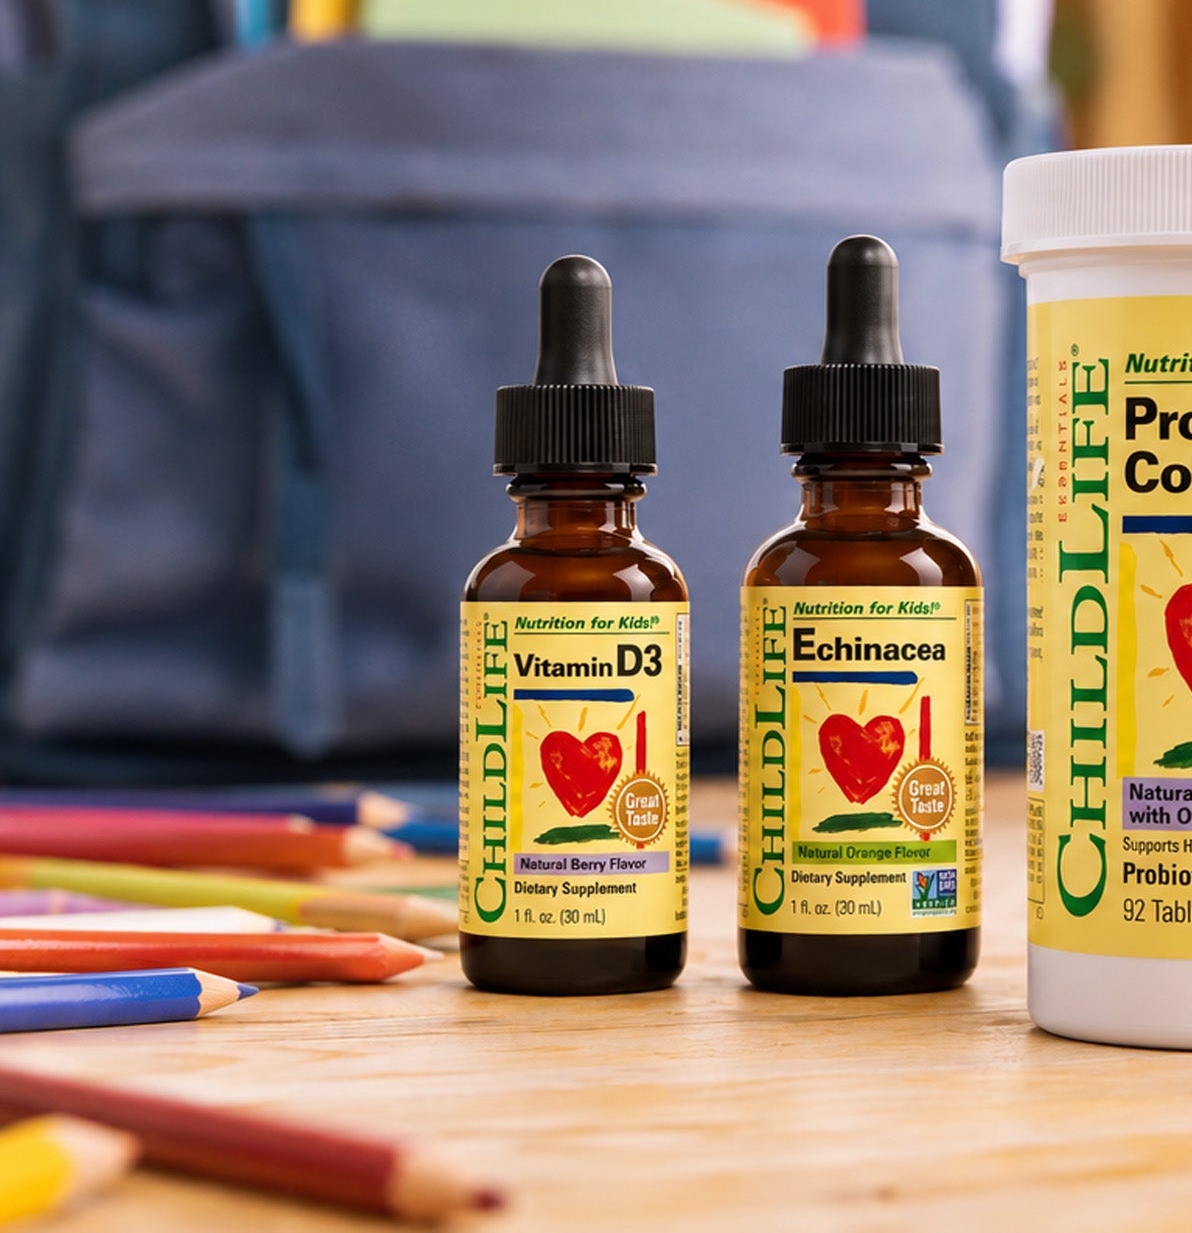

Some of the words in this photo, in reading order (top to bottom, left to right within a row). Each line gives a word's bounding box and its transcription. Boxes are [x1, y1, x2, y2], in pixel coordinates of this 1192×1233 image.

[793, 601, 863, 615] Nutrition
[870, 601, 893, 615] for
[514, 616, 585, 629] Nutrition
[590, 615, 614, 629] for
[793, 627, 946, 661] Echinacea
[514, 653, 613, 677] Vitamin
[617, 644, 662, 677] D3
[909, 779, 946, 796] Great
[910, 797, 944, 814] Taste
[625, 810, 659, 826] Taste
[1129, 806, 1170, 824] with
[798, 845, 843, 859] Natural
[846, 846, 892, 861] Orange
[1123, 836, 1179, 855] Supports
[520, 857, 567, 871] Natural
[571, 858, 606, 872] Berry
[609, 857, 646, 871] Flavor
[791, 870, 832, 887] Dietary
[835, 870, 907, 887] Supplement
[514, 881, 558, 897] Dietary
[562, 881, 637, 897] Supplement
[514, 909, 519, 923] 1
[524, 908, 535, 923] fl.
[539, 912, 556, 924] oz.
[560, 908, 579, 925] (30
[583, 908, 606, 925] mL)
[791, 900, 796, 914] 1
[800, 900, 811, 914] fl.
[815, 903, 831, 915] oz.
[835, 900, 856, 917] (30
[858, 900, 882, 917] mL)
[1123, 898, 1145, 922] 92
